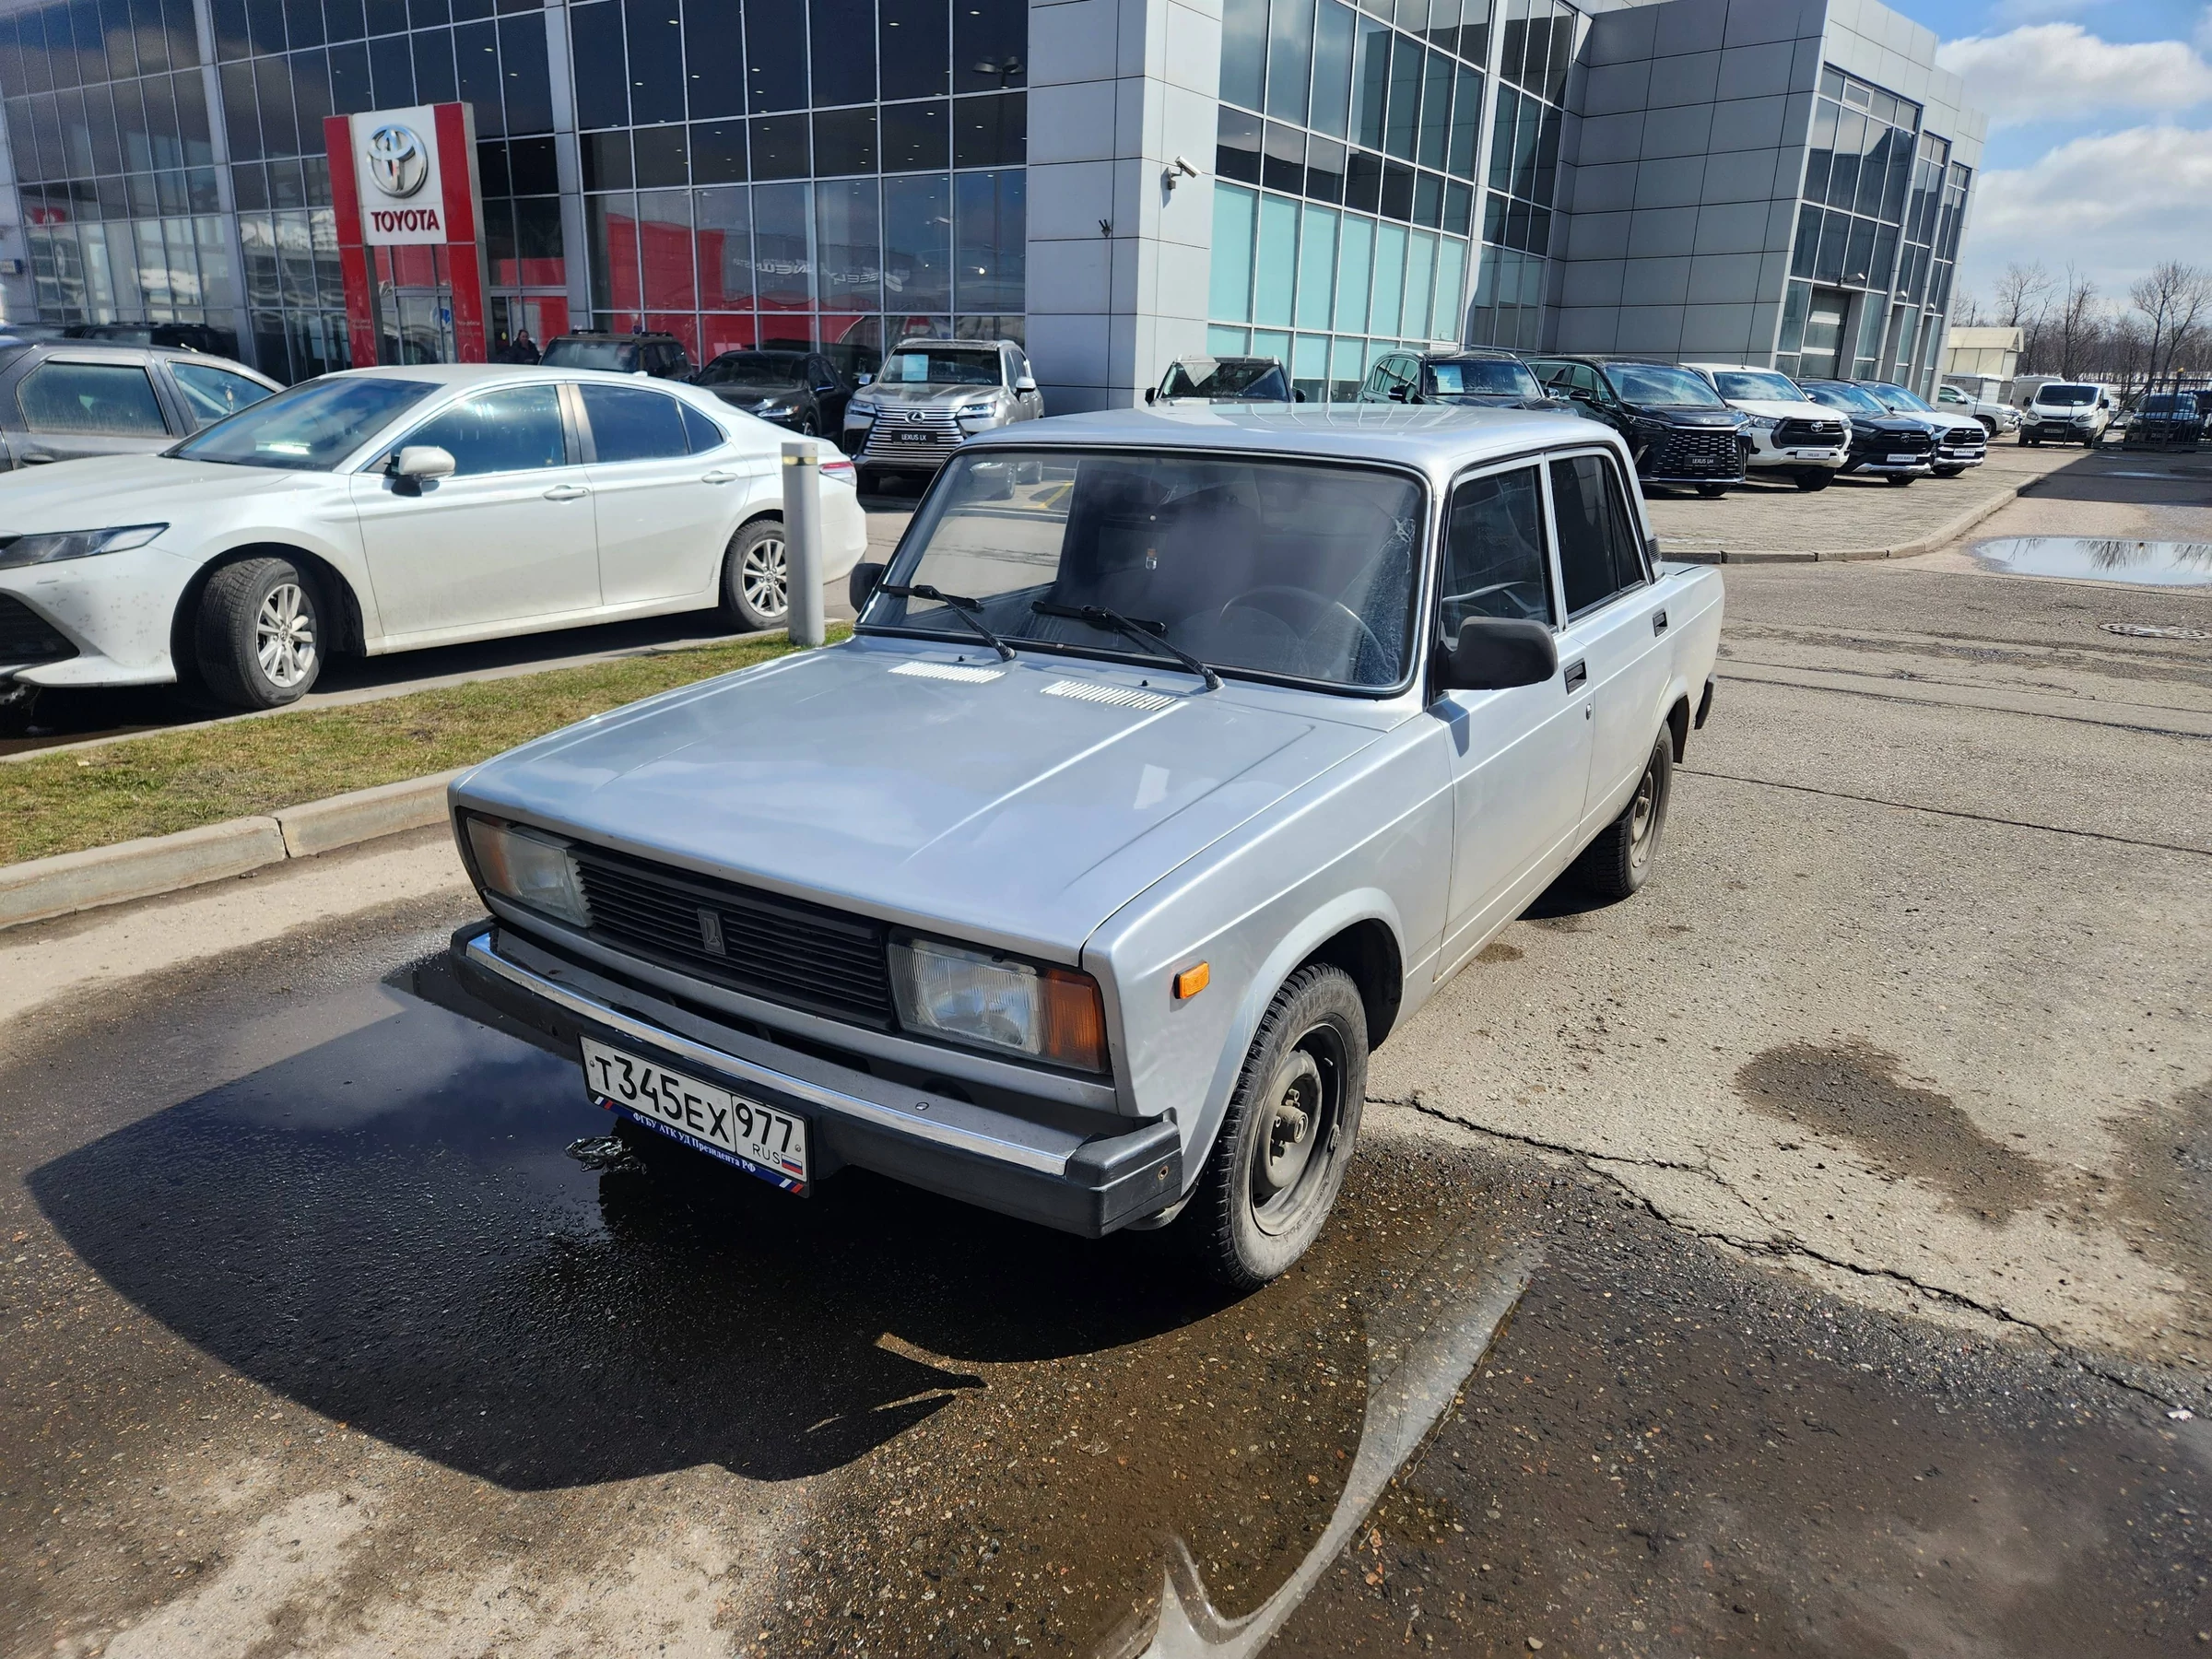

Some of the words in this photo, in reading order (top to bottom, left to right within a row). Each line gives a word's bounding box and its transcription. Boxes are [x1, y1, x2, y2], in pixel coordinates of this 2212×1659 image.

[371, 209, 440, 232] TOYOTA
[594, 1054, 730, 1143] Т345ЕХ
[735, 1102, 793, 1152] 977
[632, 1112, 656, 1129] ФГБУ
[659, 1124, 677, 1138] АТК
[679, 1133, 691, 1146] УД
[691, 1139, 740, 1167] Президента
[741, 1159, 757, 1172] РФ
[752, 1143, 781, 1165] RUS
